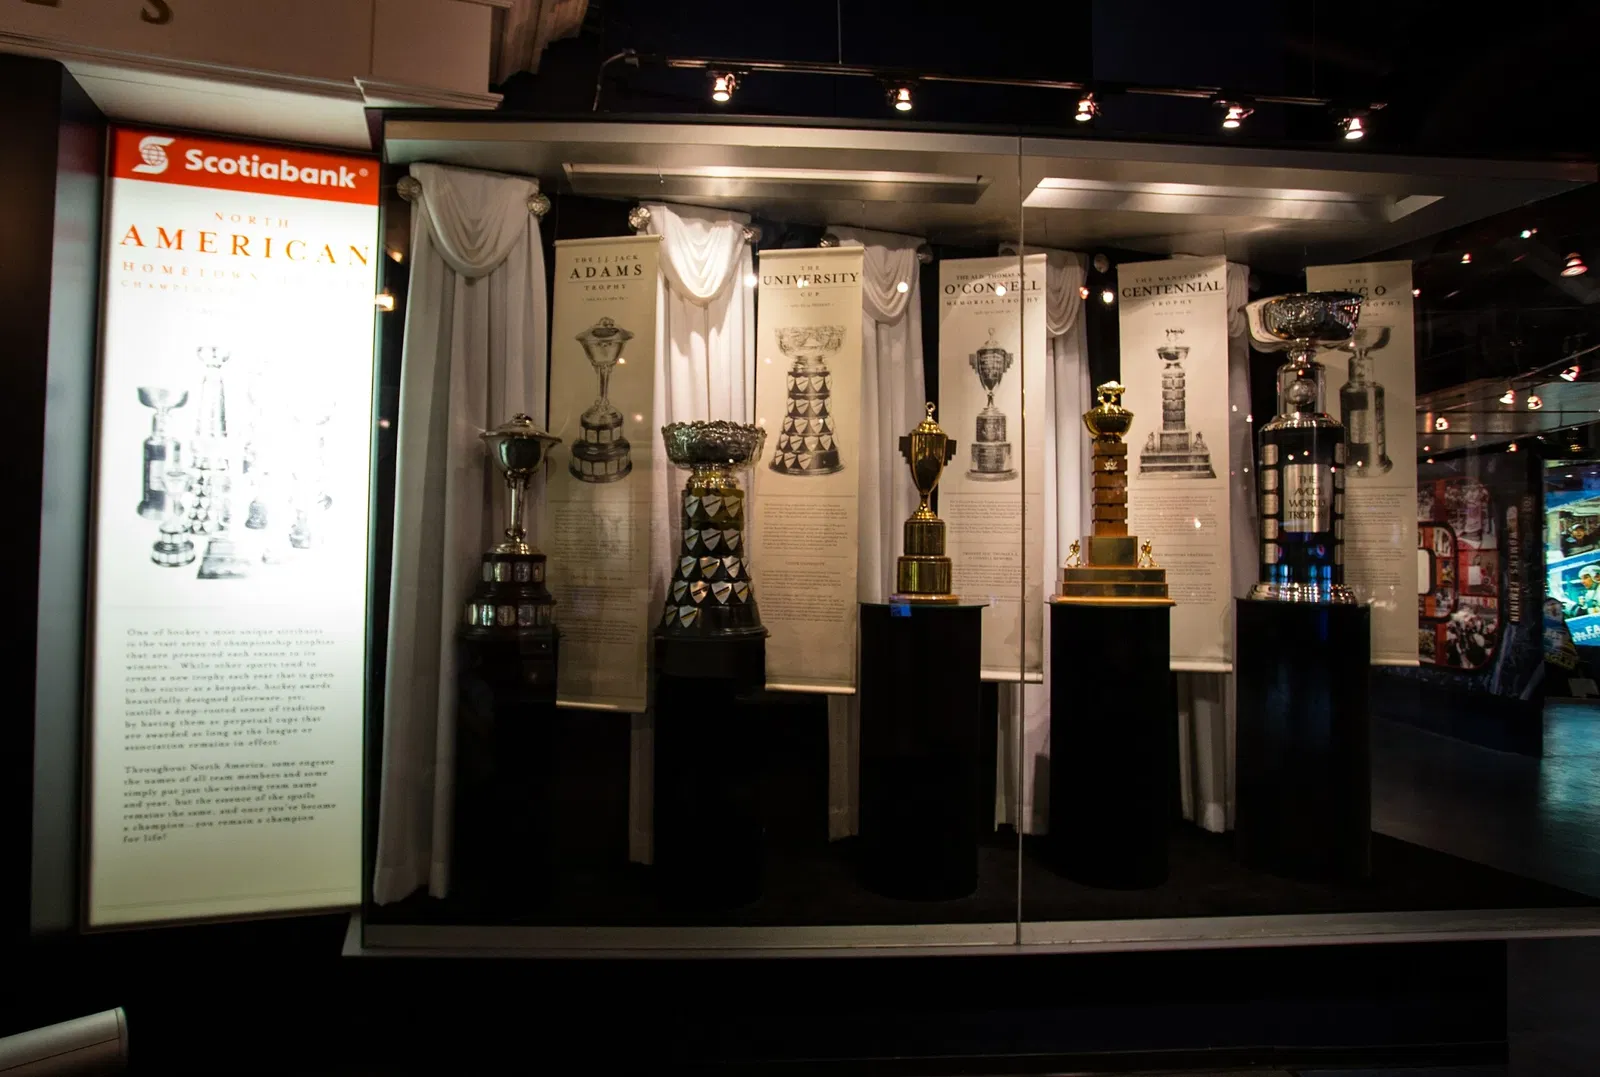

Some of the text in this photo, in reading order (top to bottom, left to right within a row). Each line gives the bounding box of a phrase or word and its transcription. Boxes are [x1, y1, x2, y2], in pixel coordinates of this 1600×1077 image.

[185, 148, 357, 189] Scotiabank
[214, 211, 290, 229] NORTH
[119, 223, 370, 267] AMERICAN
[570, 263, 643, 279] ADAMS
[763, 272, 859, 286] UNIVERSITY
[584, 283, 627, 291] TROPHY
[1121, 280, 1223, 299] CENTENNIAL
[1288, 500, 1326, 508] WORLD
